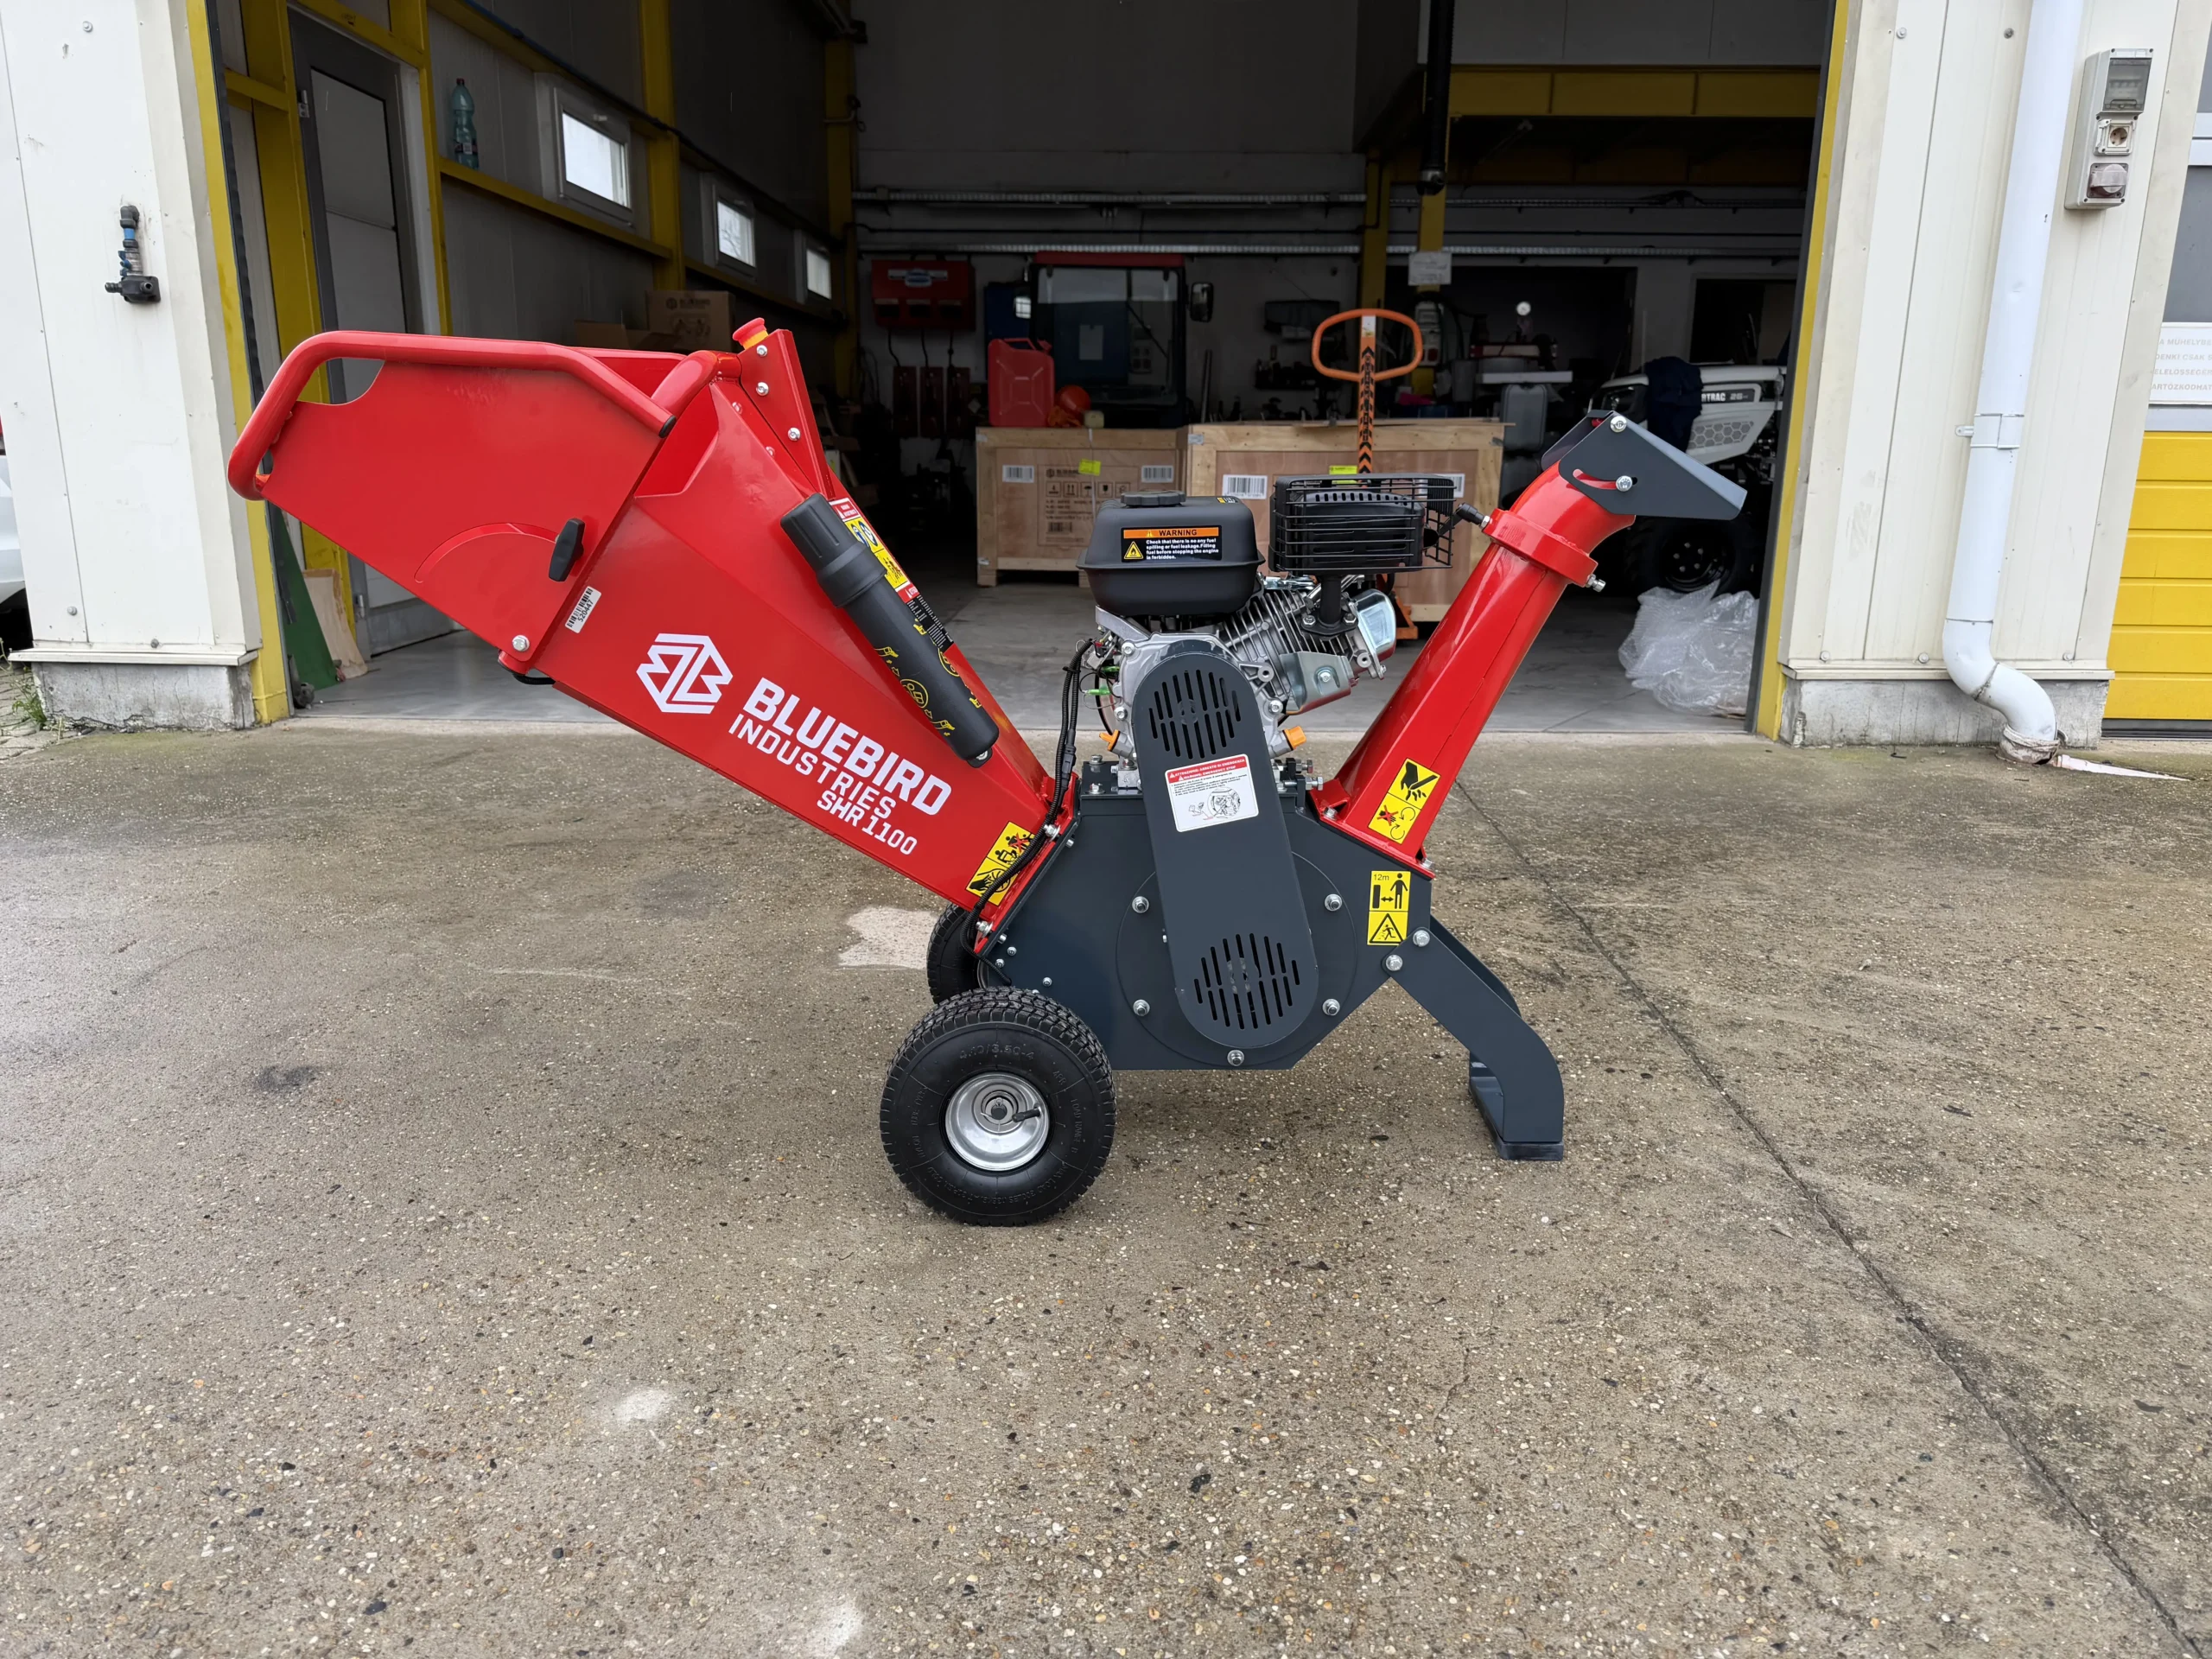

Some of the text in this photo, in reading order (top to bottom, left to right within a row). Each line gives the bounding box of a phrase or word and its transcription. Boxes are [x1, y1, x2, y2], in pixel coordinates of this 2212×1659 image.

[577, 599, 594, 623] 520447
[728, 714, 896, 820] INDUSTRIES
[743, 677, 952, 816] BLUEBIRD
